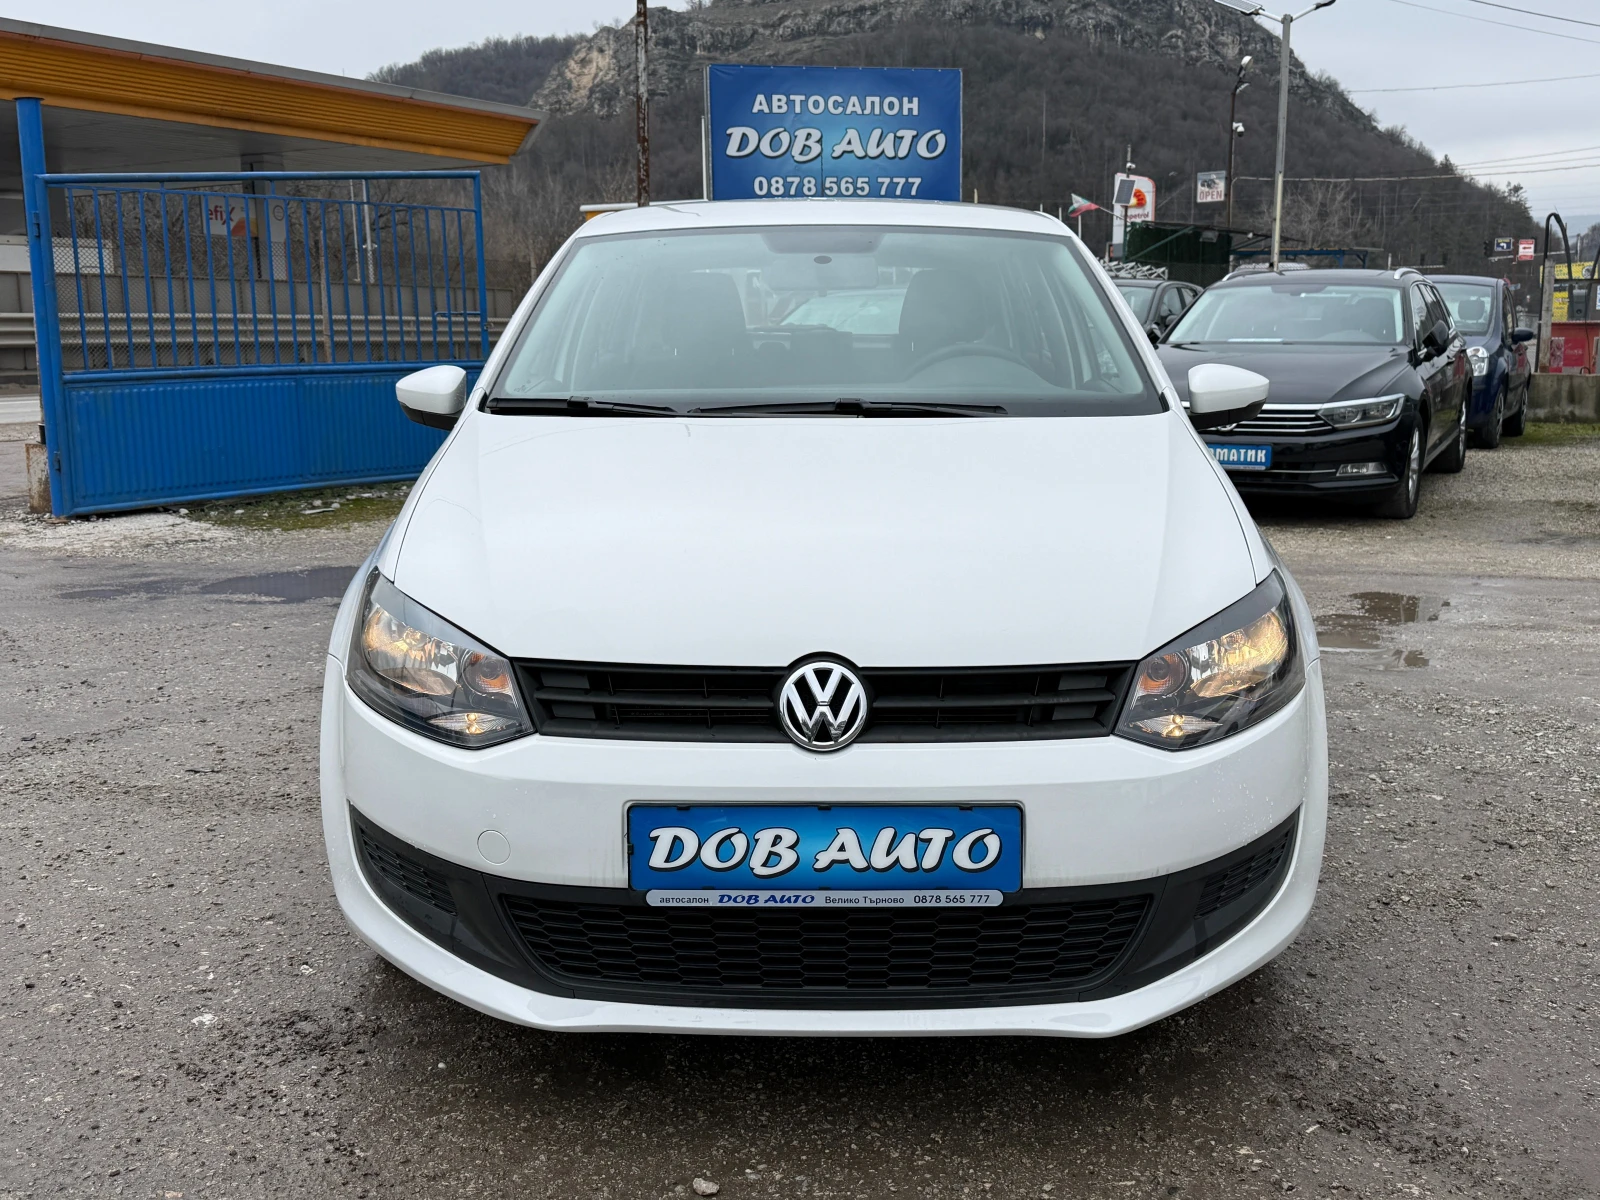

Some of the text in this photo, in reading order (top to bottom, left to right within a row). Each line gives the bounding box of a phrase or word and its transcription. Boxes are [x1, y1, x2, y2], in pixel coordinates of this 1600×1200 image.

[752, 94, 919, 116] АВТОСАЛОН
[725, 126, 947, 163] DOB AUTO
[753, 176, 922, 196] 0878 565 777
[1199, 190, 1223, 201] OPEN
[648, 827, 1002, 878] DOB AUTO
[659, 894, 990, 906] автосалон DOB AUTO Велико Търново 0878 565 777
